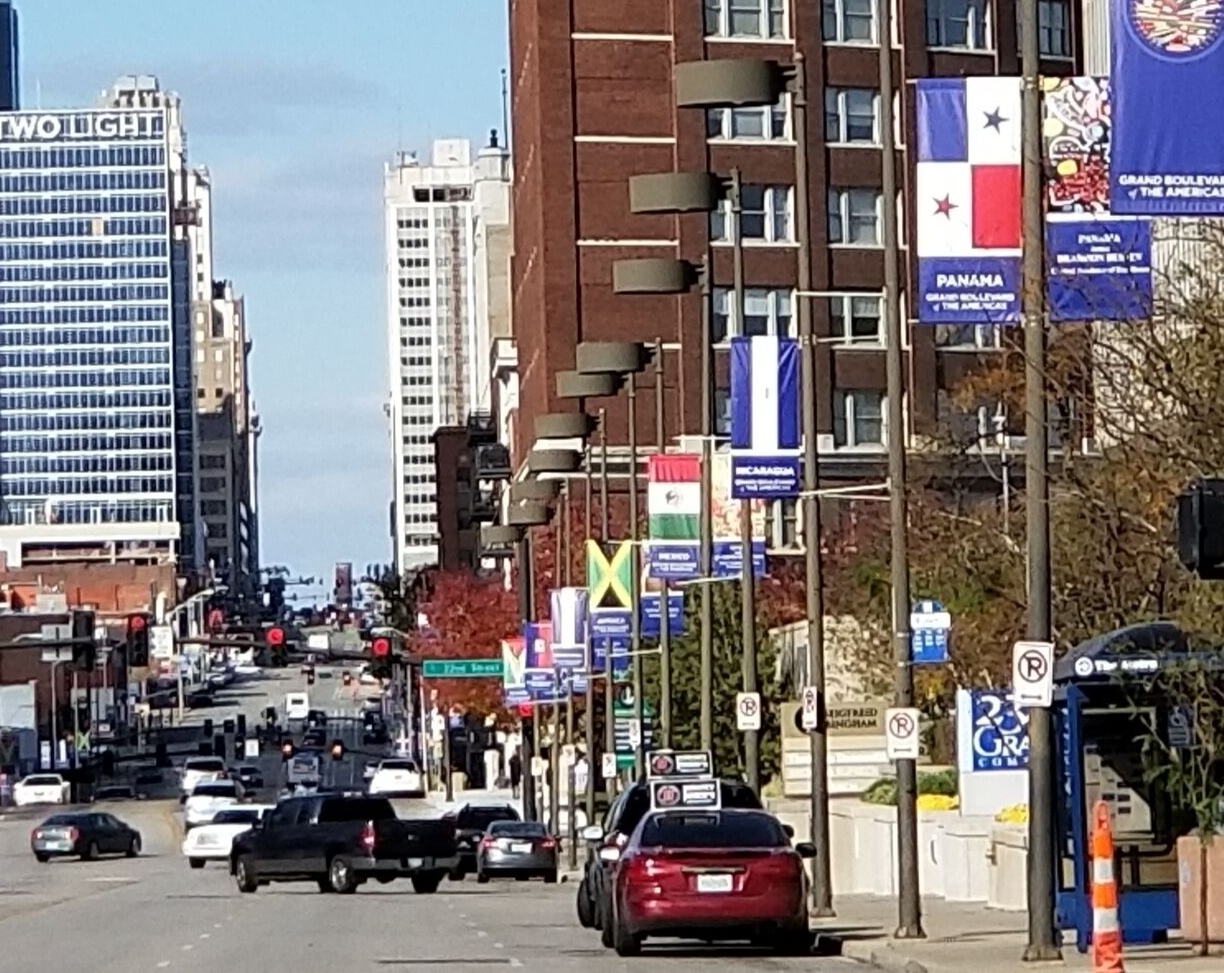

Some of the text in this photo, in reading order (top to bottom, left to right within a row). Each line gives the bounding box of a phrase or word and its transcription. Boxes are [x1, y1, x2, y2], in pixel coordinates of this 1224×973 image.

[70, 113, 159, 138] LIGHT
[1118, 174, 1163, 185] GRAND
[1140, 187, 1163, 197] THE
[936, 274, 1004, 287] PANAMA
[978, 757, 1029, 767] COM
